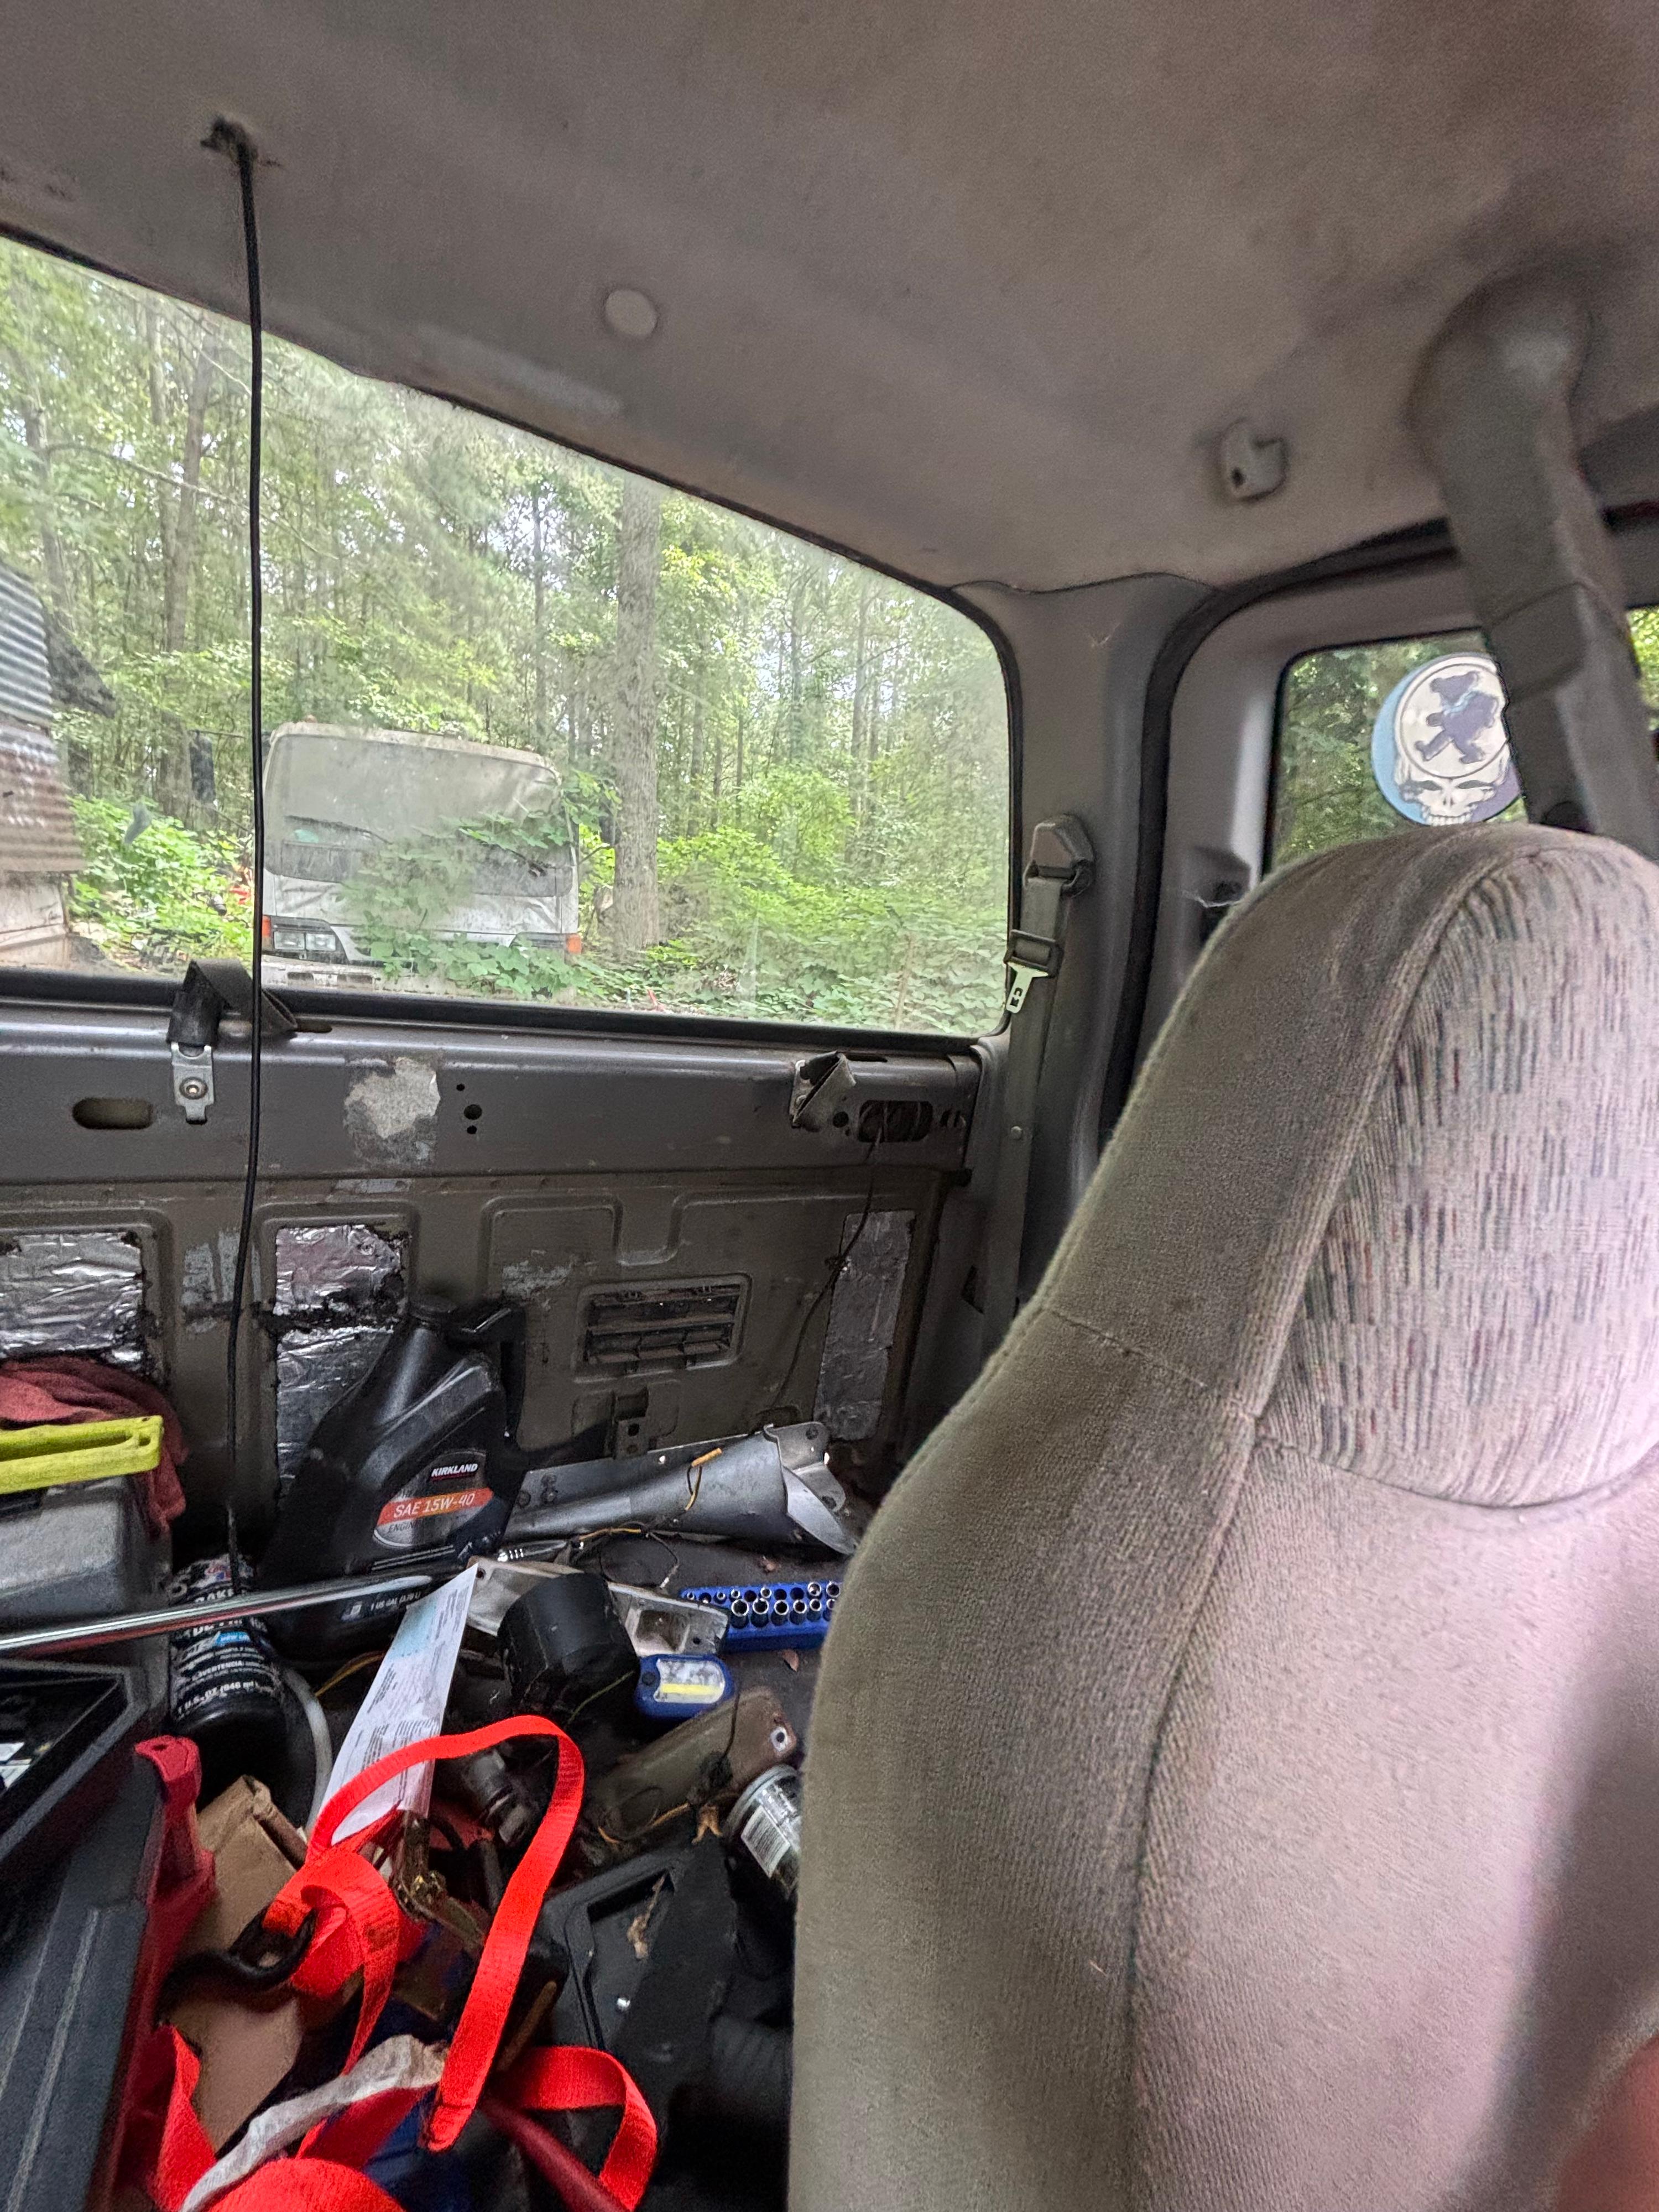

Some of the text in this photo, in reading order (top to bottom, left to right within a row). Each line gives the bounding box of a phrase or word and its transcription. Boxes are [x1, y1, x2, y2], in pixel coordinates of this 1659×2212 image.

[431, 1463, 478, 1477] KIRKLAND
[393, 1493, 475, 1518] SAE 15W-40
